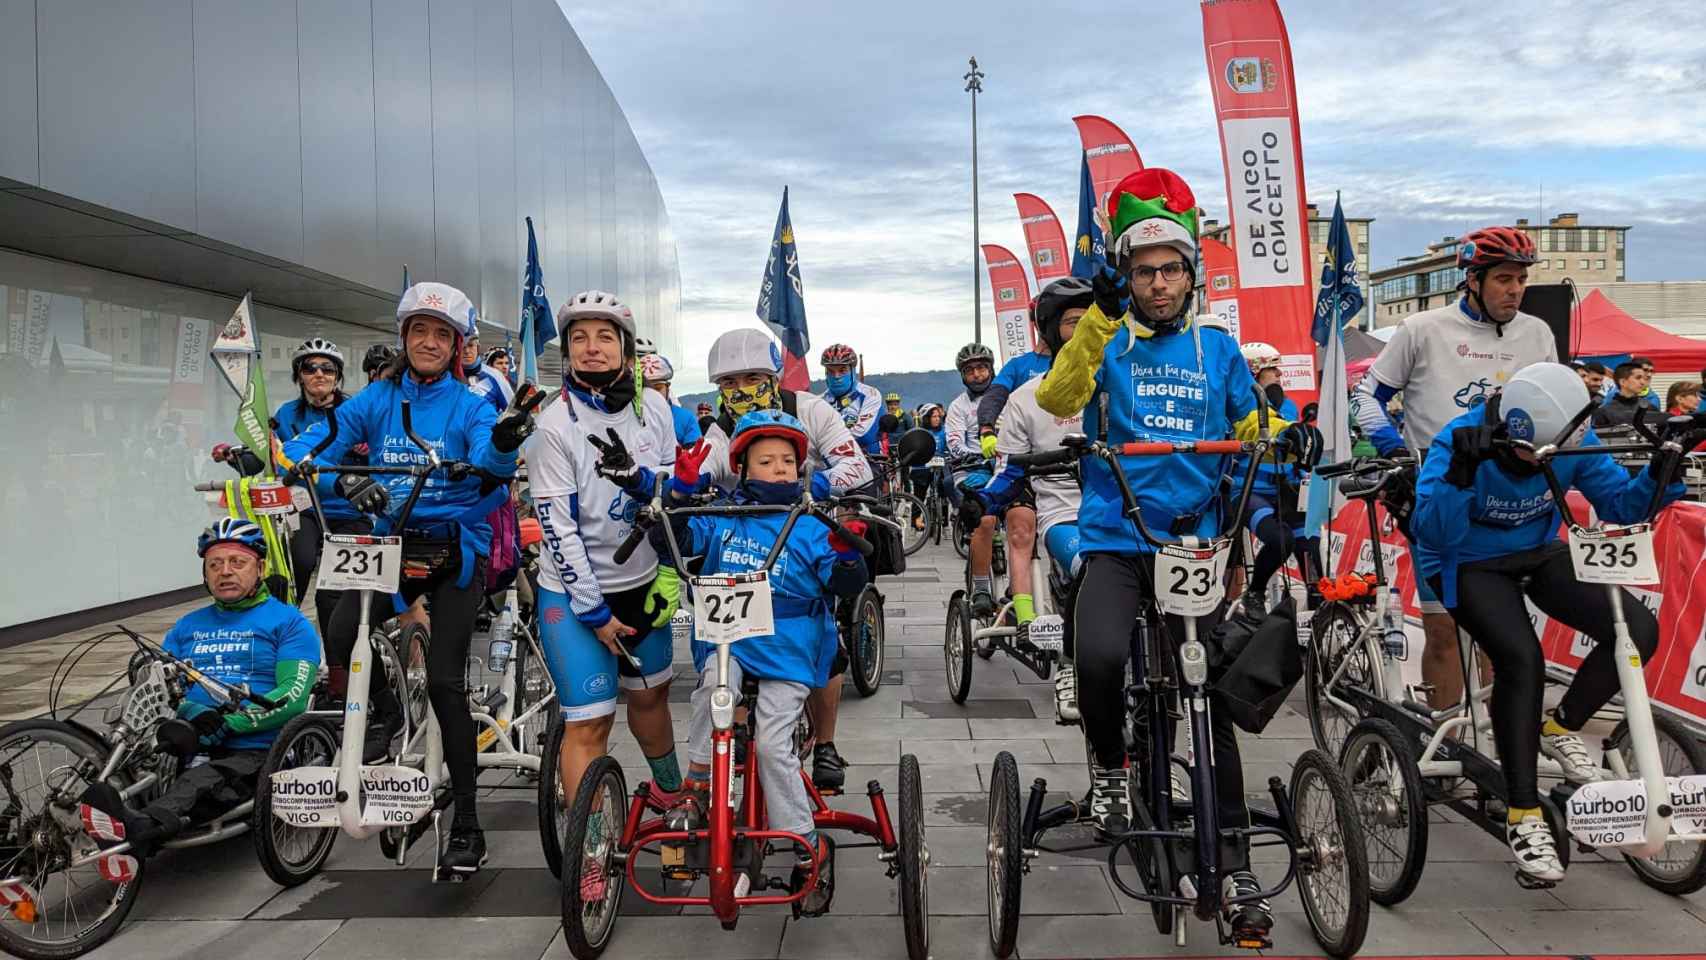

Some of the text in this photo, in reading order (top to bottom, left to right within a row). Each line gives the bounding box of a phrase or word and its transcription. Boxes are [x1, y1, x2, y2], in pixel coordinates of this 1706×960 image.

[1136, 381, 1204, 401] ÉRGUETE
[1165, 400, 1175, 413] E
[1143, 414, 1195, 432] CORRE
[383, 448, 430, 465] ÉRGUET
[260, 490, 279, 504] 51
[537, 502, 579, 585] turbo10
[333, 549, 383, 576] 231
[722, 548, 782, 577] ÉRGUEE
[1580, 542, 1638, 568] 235
[1169, 565, 1217, 597] 23
[705, 590, 754, 624] 227
[194, 642, 250, 654] ÉRGUETE
[215, 655, 223, 664] E
[363, 776, 429, 793] turbo10
[1571, 794, 1645, 816] turbo10
[1671, 787, 1706, 806] tur
[286, 812, 321, 824] VIGO
[383, 809, 414, 822] VIGO
[1588, 831, 1625, 843] VIGO
